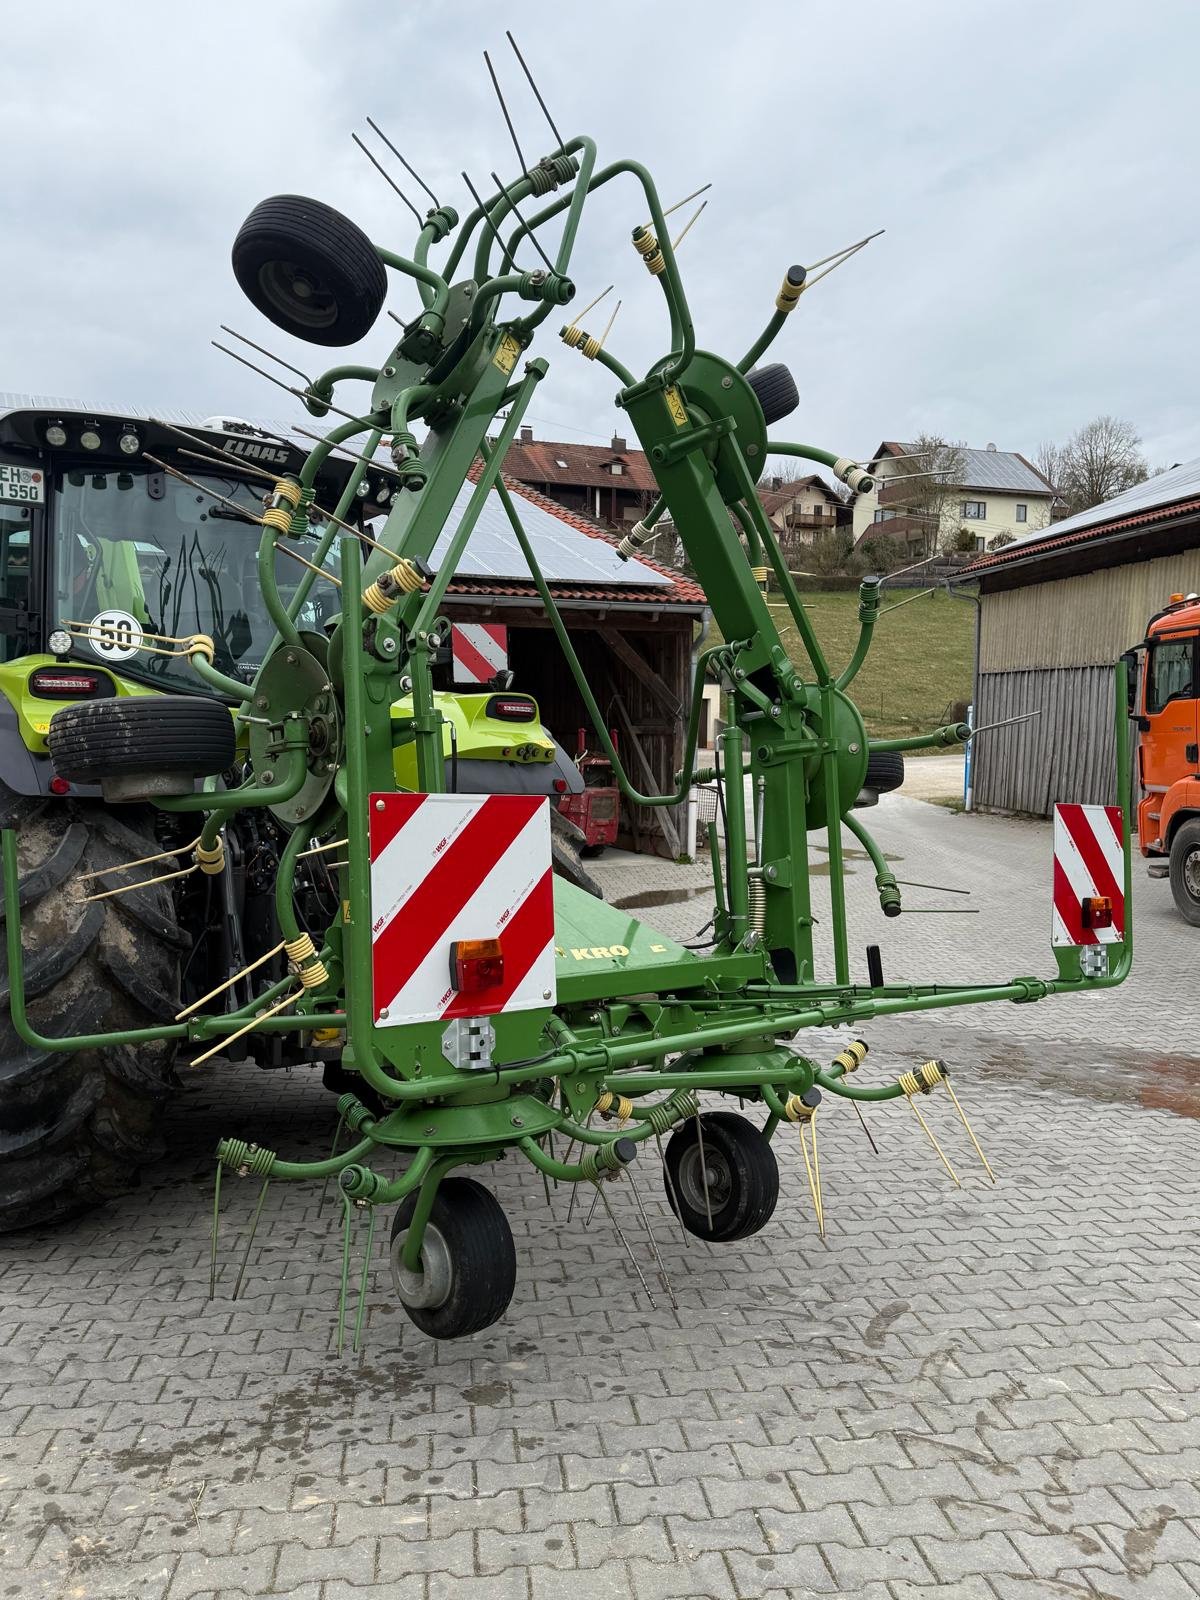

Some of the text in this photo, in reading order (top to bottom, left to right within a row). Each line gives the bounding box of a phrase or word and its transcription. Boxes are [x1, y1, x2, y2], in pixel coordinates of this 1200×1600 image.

[223, 439, 290, 464] CLAAS
[9, 483, 39, 501] 550
[100, 619, 132, 652] 50
[372, 916, 384, 933] WGF
[570, 944, 667, 961] KROE
